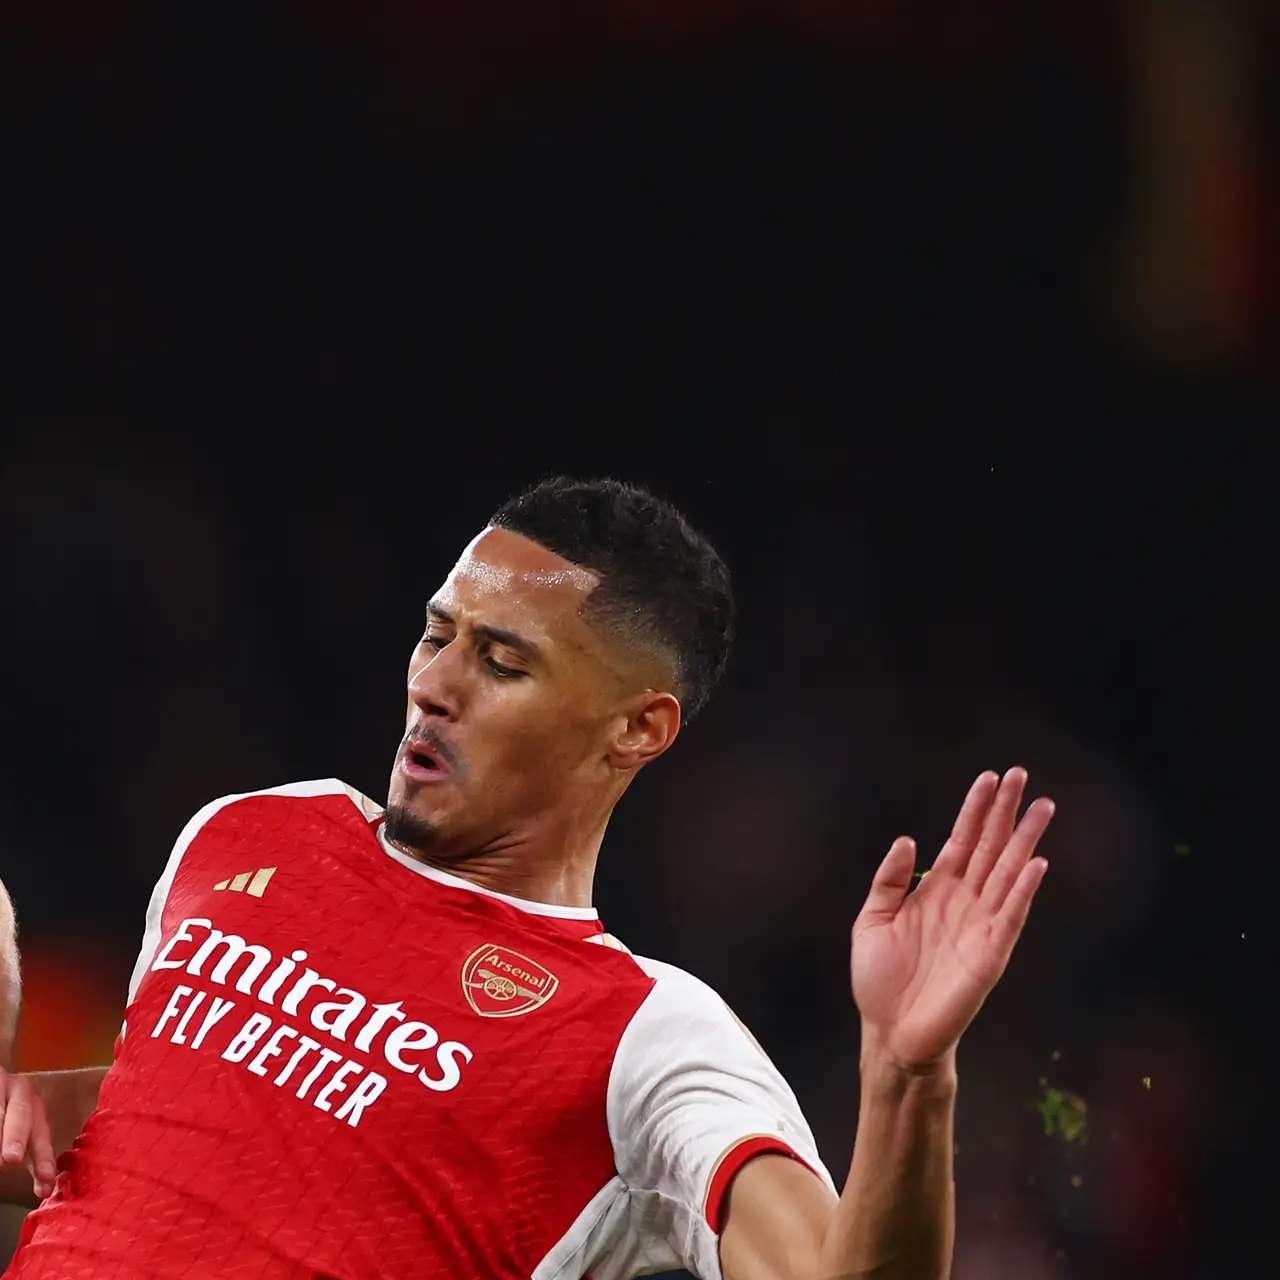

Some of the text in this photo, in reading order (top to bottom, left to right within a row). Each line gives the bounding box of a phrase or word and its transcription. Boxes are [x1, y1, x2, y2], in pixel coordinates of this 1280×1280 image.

[151, 917, 473, 1092] Emirates
[484, 954, 546, 988] Arsenal
[150, 984, 388, 1128] FLY BETTER
